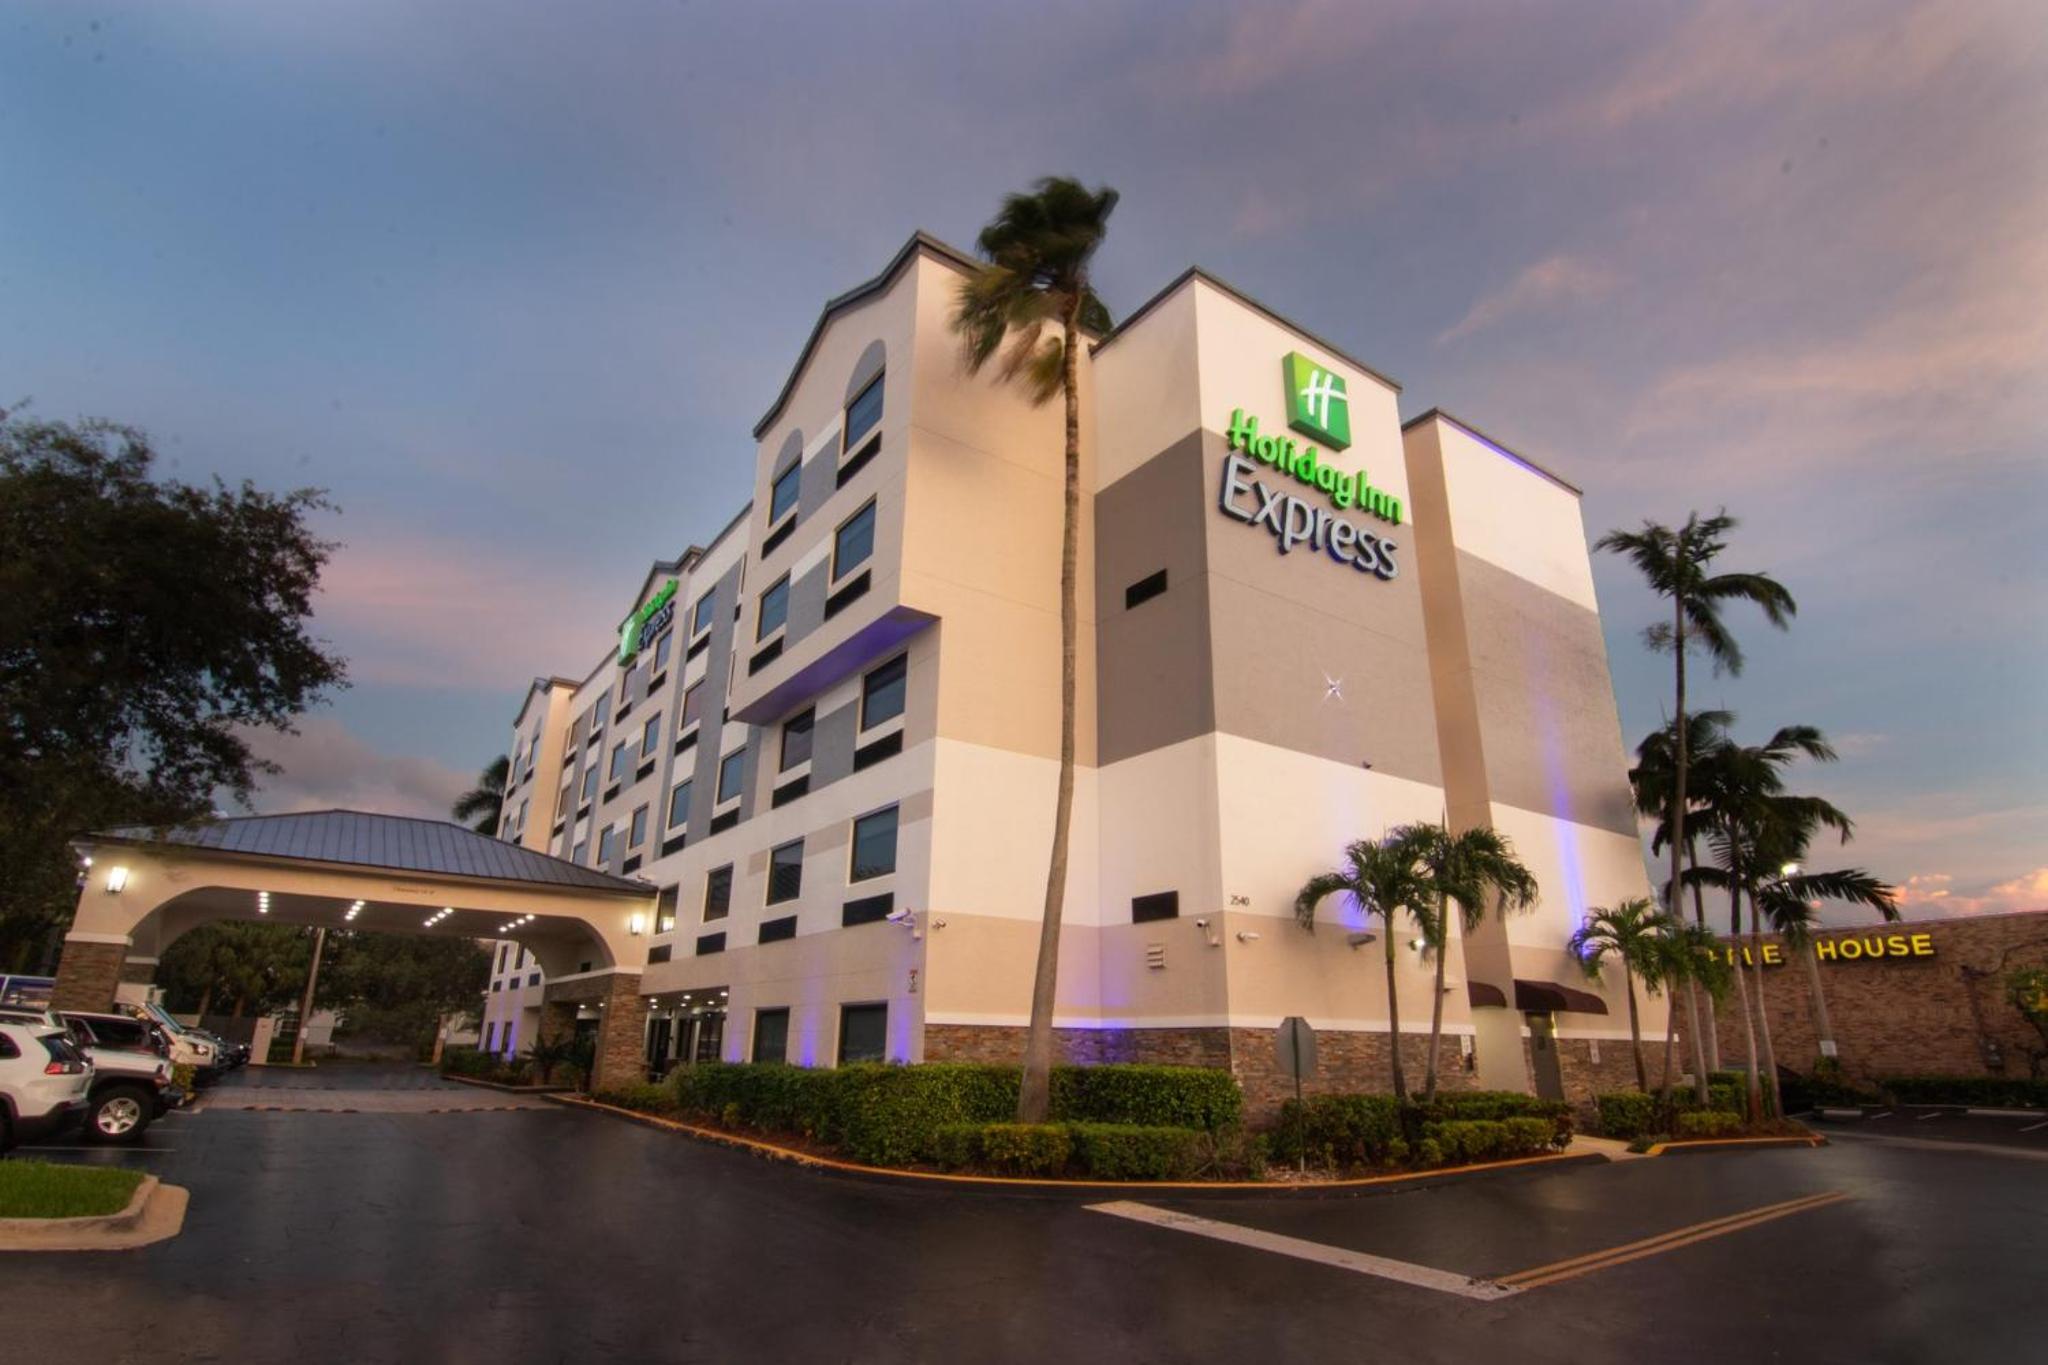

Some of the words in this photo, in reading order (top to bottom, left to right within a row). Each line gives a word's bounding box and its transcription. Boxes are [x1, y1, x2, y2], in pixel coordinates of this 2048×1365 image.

[1219, 453, 1400, 580] Express
[1226, 408, 1356, 510] Holiday
[1356, 470, 1404, 525] Inn
[1816, 934, 1935, 960] HOUSE
